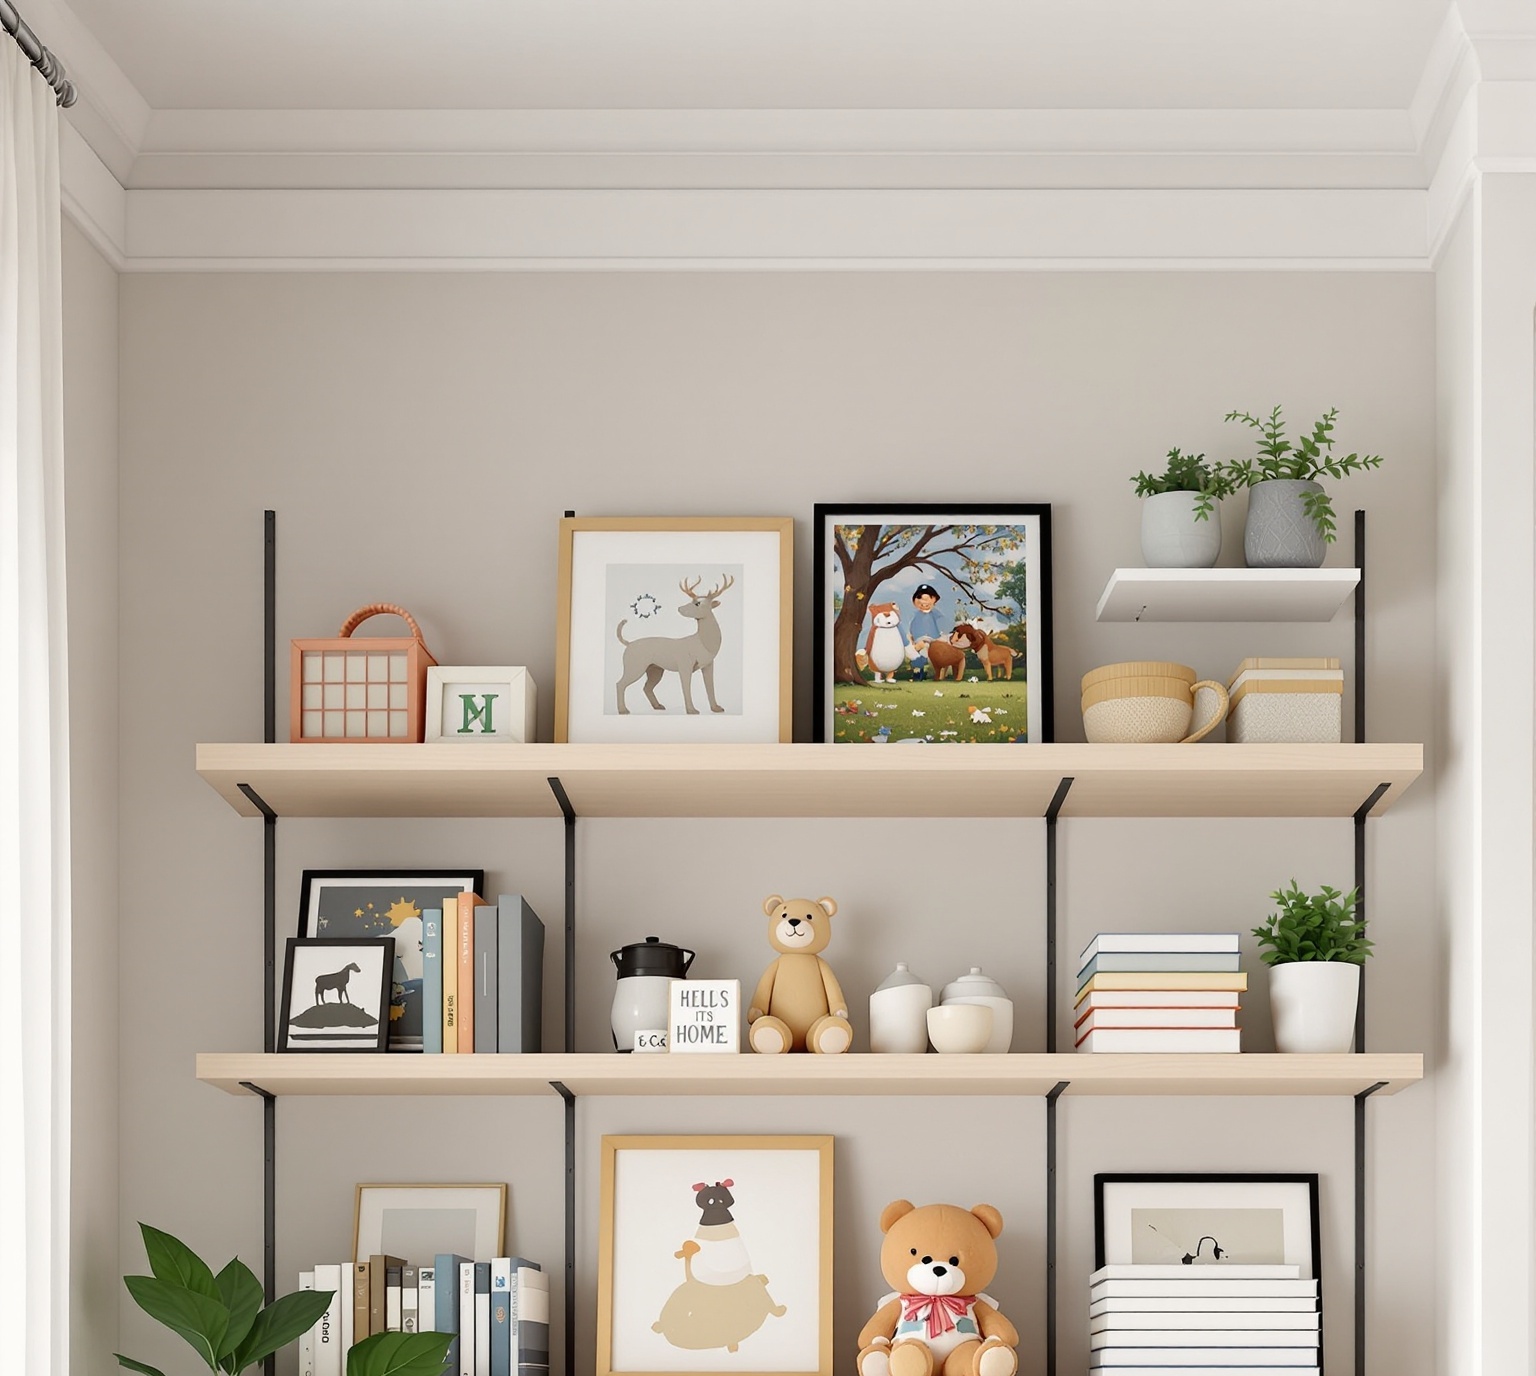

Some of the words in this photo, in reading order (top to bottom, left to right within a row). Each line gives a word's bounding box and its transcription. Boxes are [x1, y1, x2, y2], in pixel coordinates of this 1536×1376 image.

[457, 694, 499, 733] M
[695, 1010, 714, 1022] ITS
[677, 1025, 728, 1043] HOME
